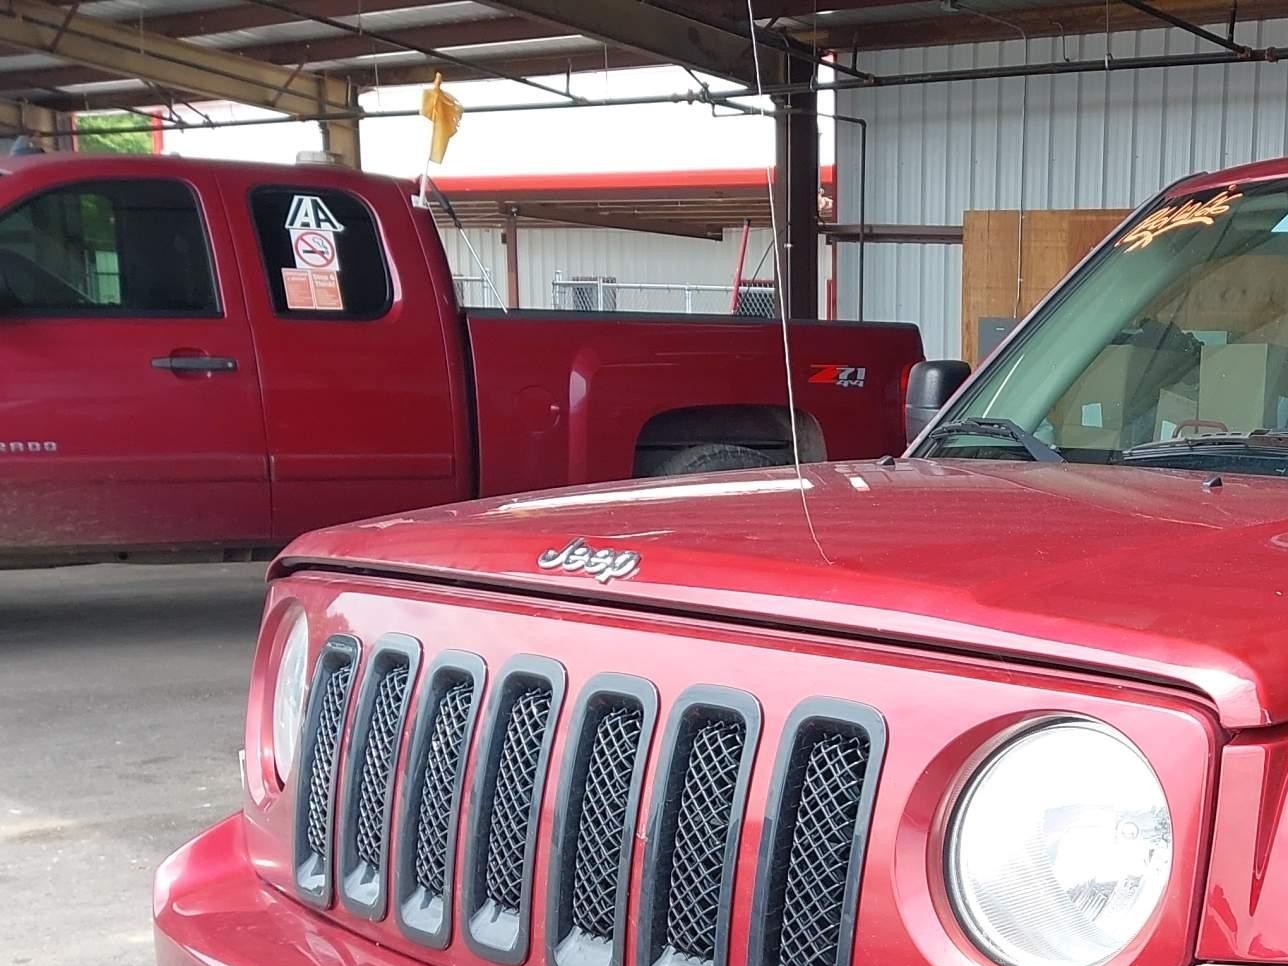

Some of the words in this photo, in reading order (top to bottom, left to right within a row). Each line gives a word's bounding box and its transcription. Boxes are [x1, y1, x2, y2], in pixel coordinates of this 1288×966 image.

[286, 195, 342, 231] IAA
[808, 364, 866, 384] Z71
[538, 536, 641, 585] Jeep
